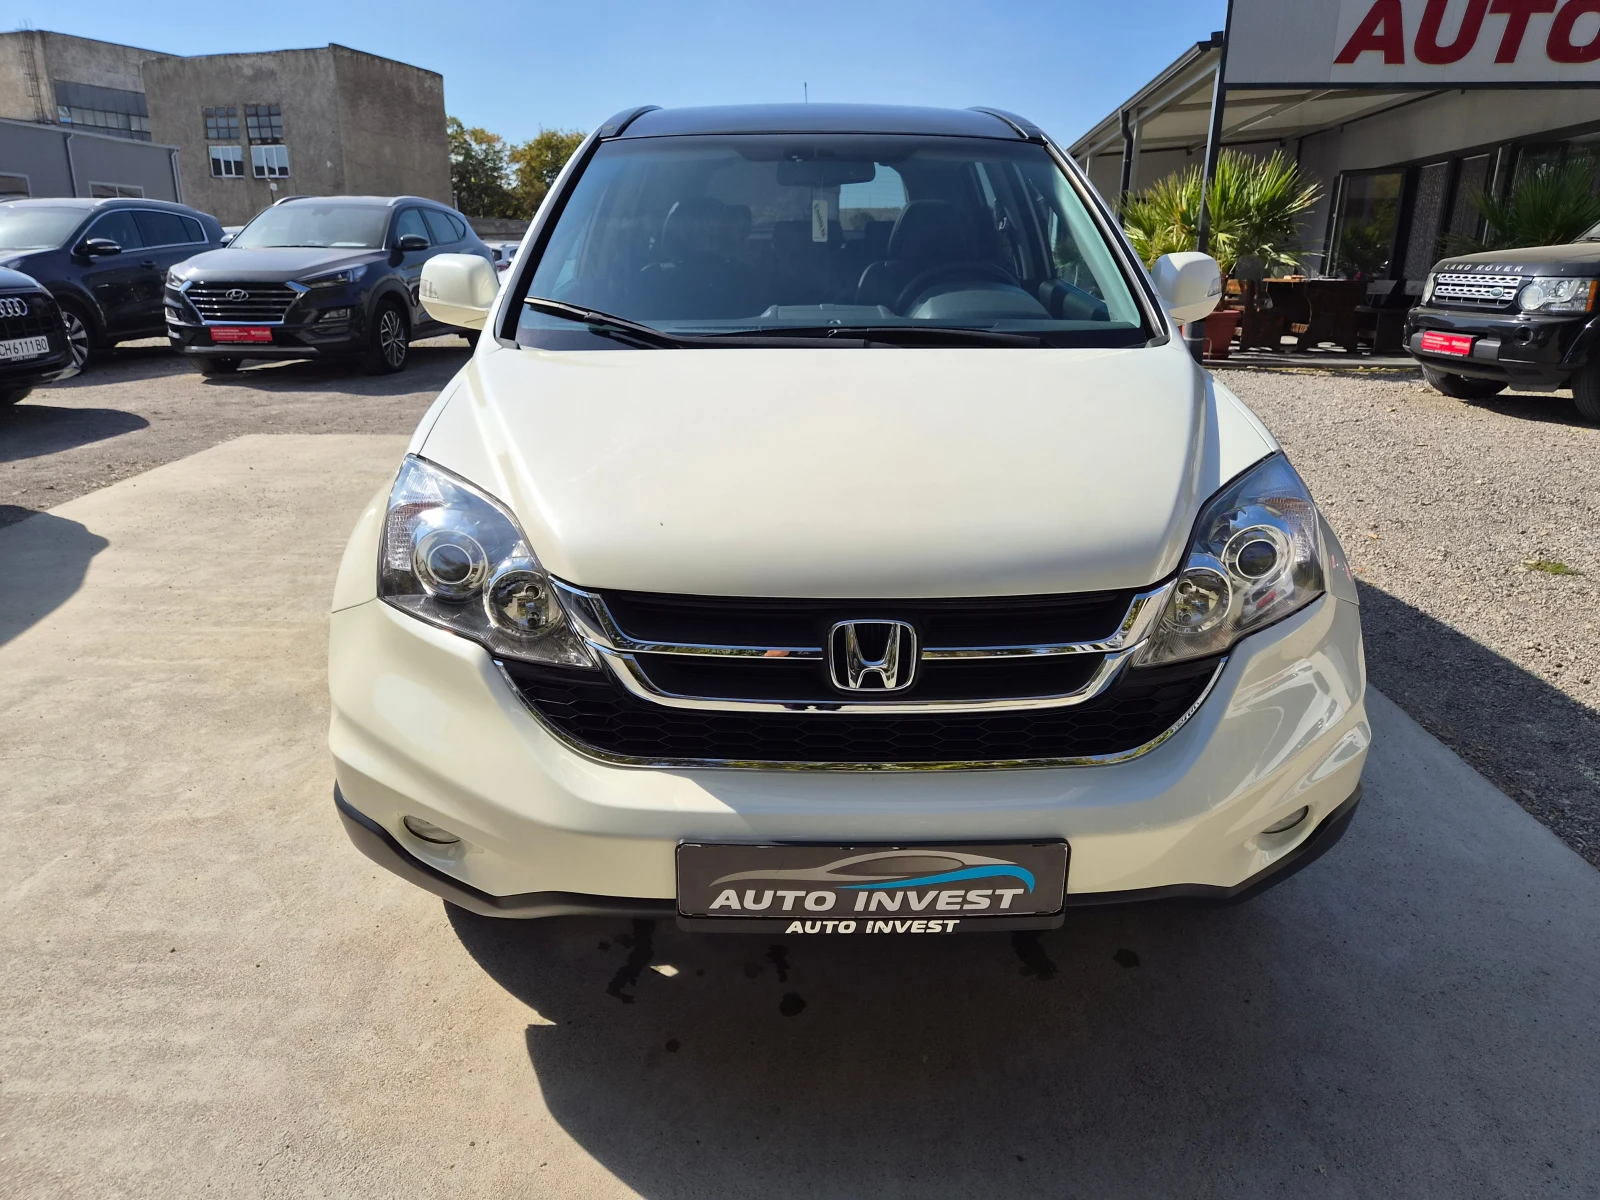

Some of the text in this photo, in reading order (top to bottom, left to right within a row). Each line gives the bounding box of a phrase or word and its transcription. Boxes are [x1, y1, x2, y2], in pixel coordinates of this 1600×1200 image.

[1333, 0, 1600, 65] AUTO
[1443, 263, 1524, 273] LAND ROVER
[708, 888, 1026, 911] AUTO INVEST
[784, 919, 961, 934] AUTO INVEST
